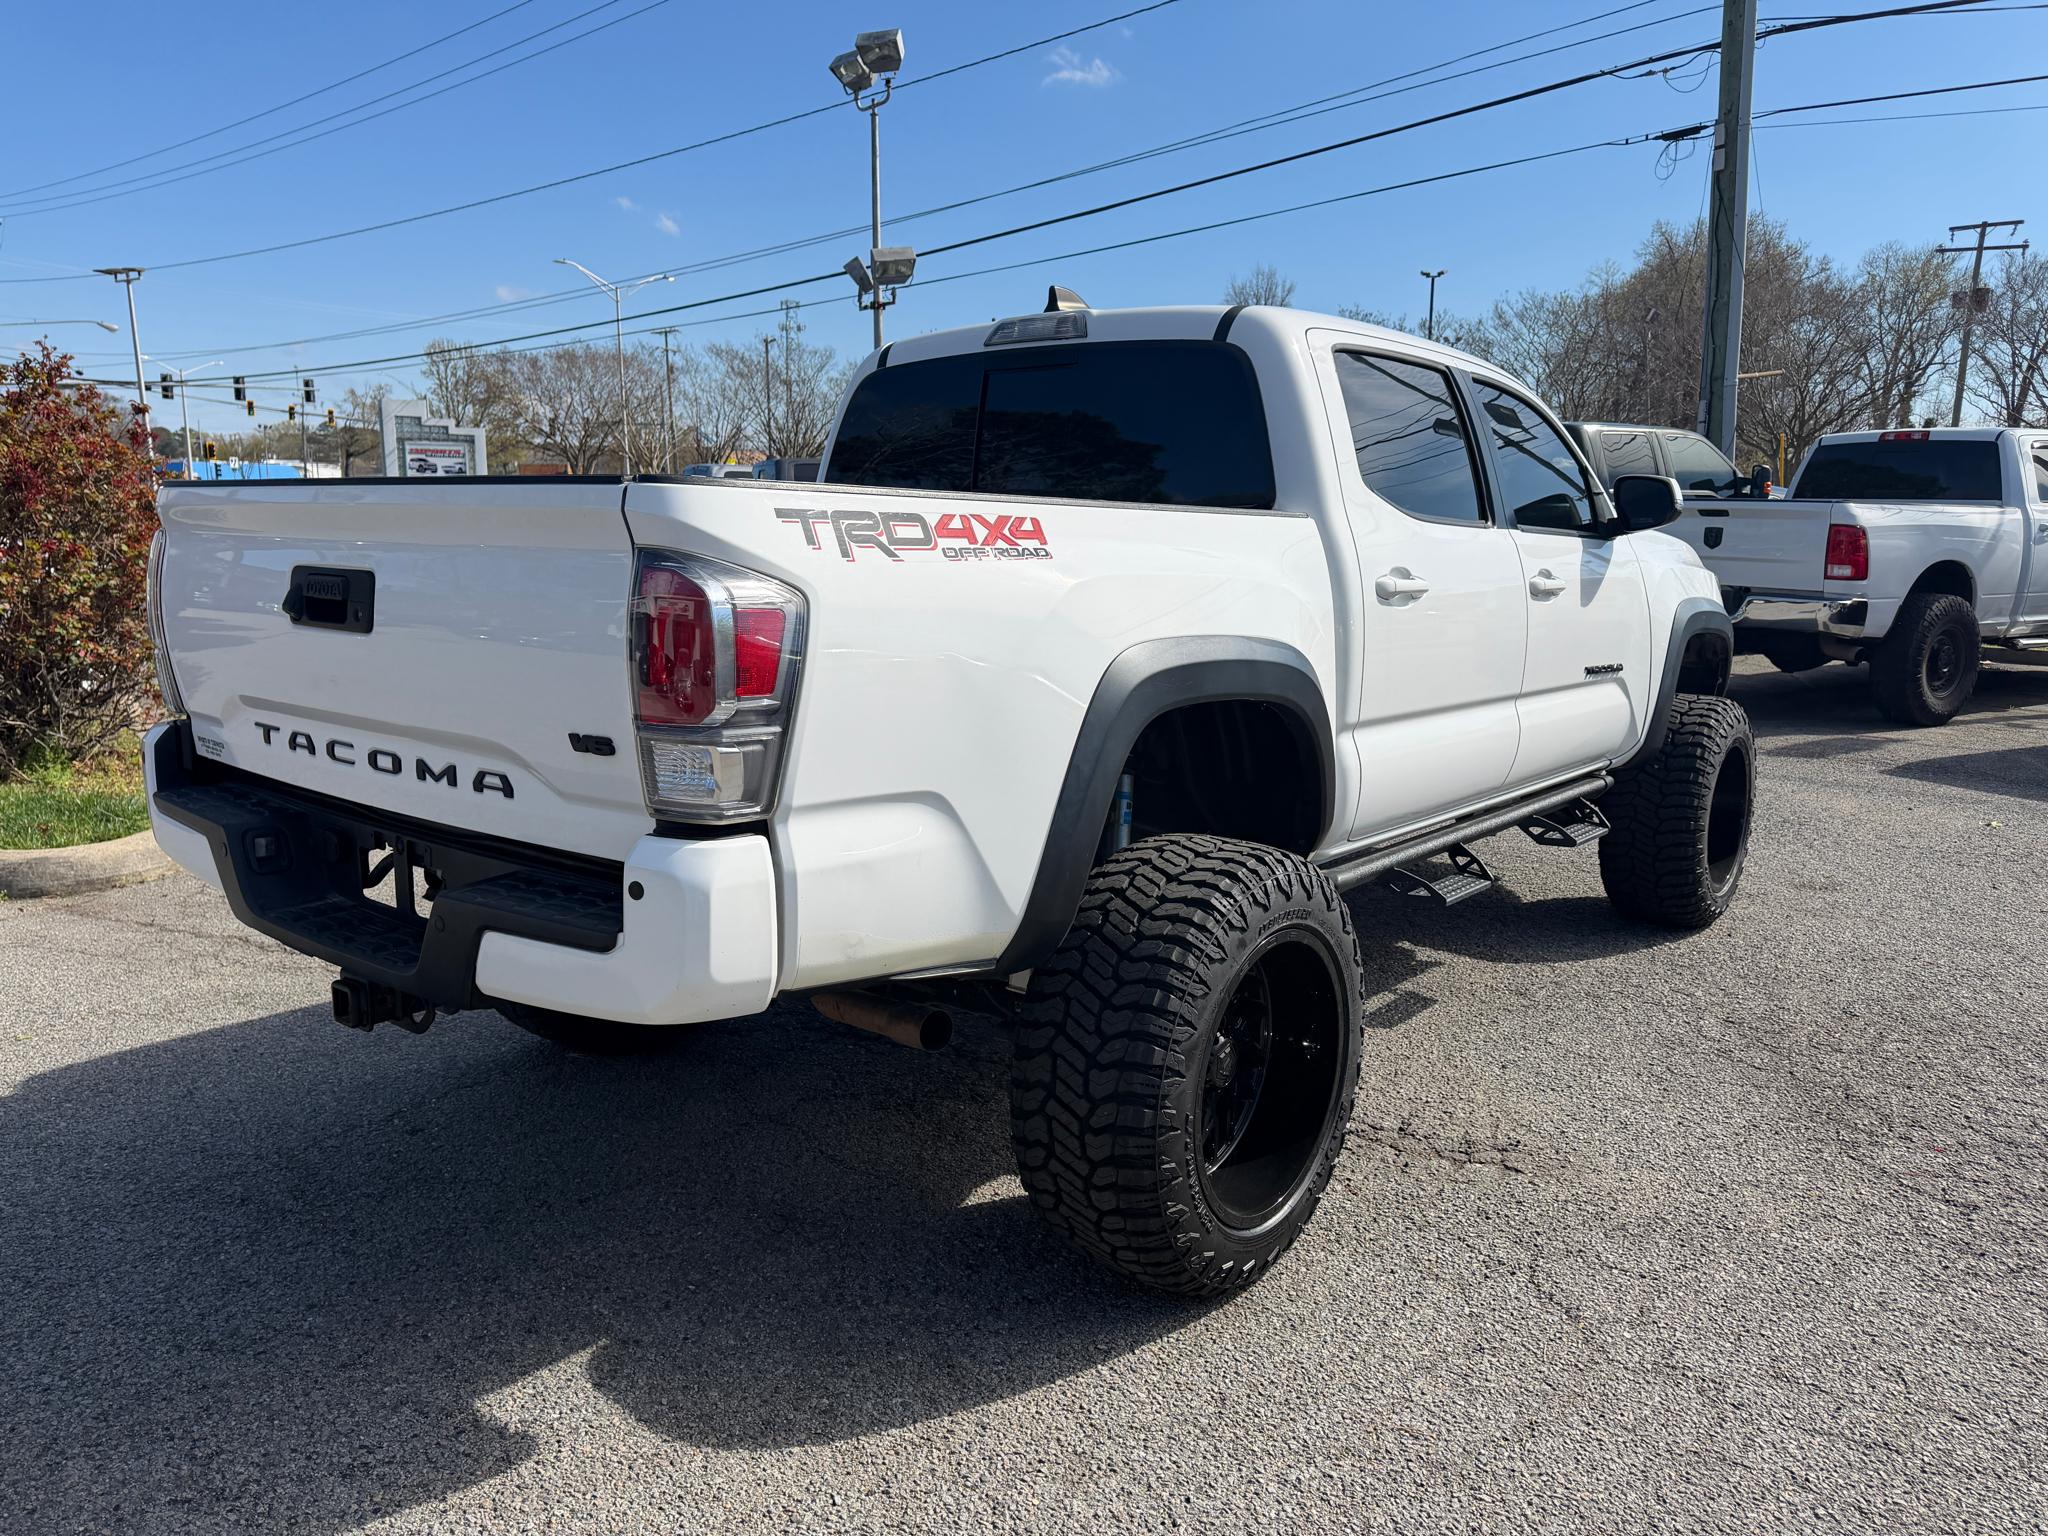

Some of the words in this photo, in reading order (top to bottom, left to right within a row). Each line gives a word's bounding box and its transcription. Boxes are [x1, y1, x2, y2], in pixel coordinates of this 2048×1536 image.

[774, 508, 938, 563] TRD
[941, 547, 990, 561] OFF
[991, 547, 1053, 561] ROAD
[305, 581, 342, 599] TOYOTA
[568, 732, 616, 757] V6
[254, 721, 515, 798] TACOMA
